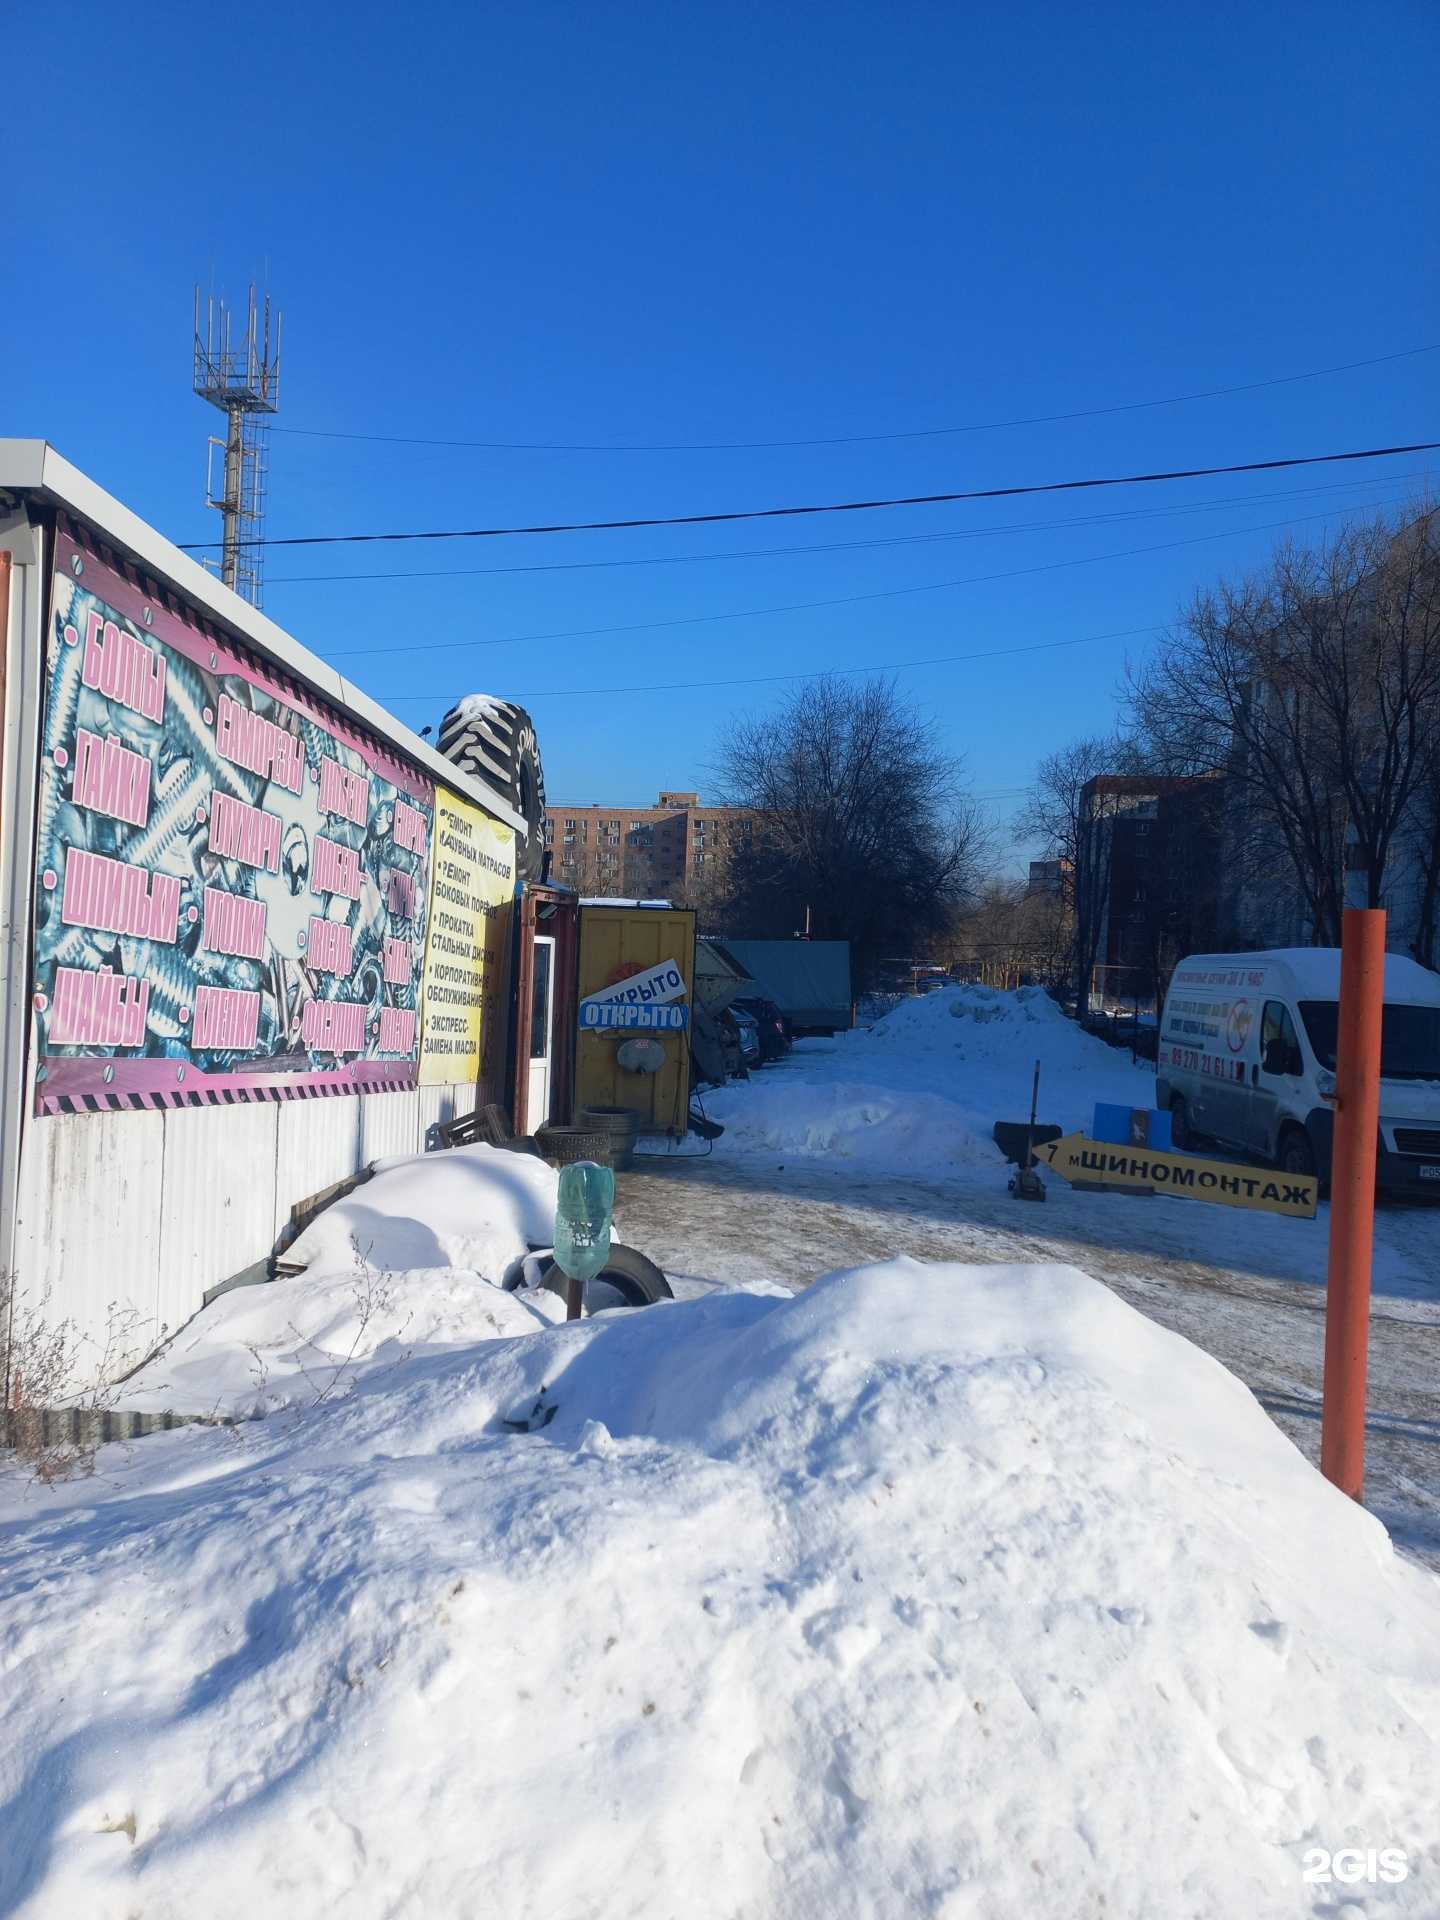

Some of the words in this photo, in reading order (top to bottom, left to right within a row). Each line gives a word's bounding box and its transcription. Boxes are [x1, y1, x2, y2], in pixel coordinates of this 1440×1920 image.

[82, 609, 166, 724] БОЛТЫ
[216, 692, 305, 795] САМОРЕЗЫ
[74, 728, 151, 827] ГАЙКИ
[208, 790, 282, 874] ГЛУХАРИ
[442, 861, 470, 887] РЕМОНТ
[478, 851, 511, 880] МАТРАСОВ
[62, 847, 180, 944] ШПИЛЬКИ
[435, 881, 471, 909] БОКОВЫХ
[202, 887, 266, 960] УГОЛКИ
[439, 912, 474, 938] ПРОКАТКА
[431, 933, 471, 958] СТАЛЬНЫХ
[427, 985, 482, 1008] ОБСЛУЖИВАНИЕ
[606, 970, 680, 1004] КРЫТО
[49, 965, 149, 1047] ШАЙБЫ
[192, 985, 261, 1050] КЛЕПКИ
[585, 1004, 682, 1027] ОТКРЫТО
[431, 1015, 468, 1033] ЭКСПРЕСС-
[424, 1038, 453, 1054] ЗАМЕНА
[454, 1040, 476, 1055] МАСЛА
[1047, 1144, 1058, 1163] 7
[1080, 1150, 1312, 1206] ШИНОМОНТАЖ
